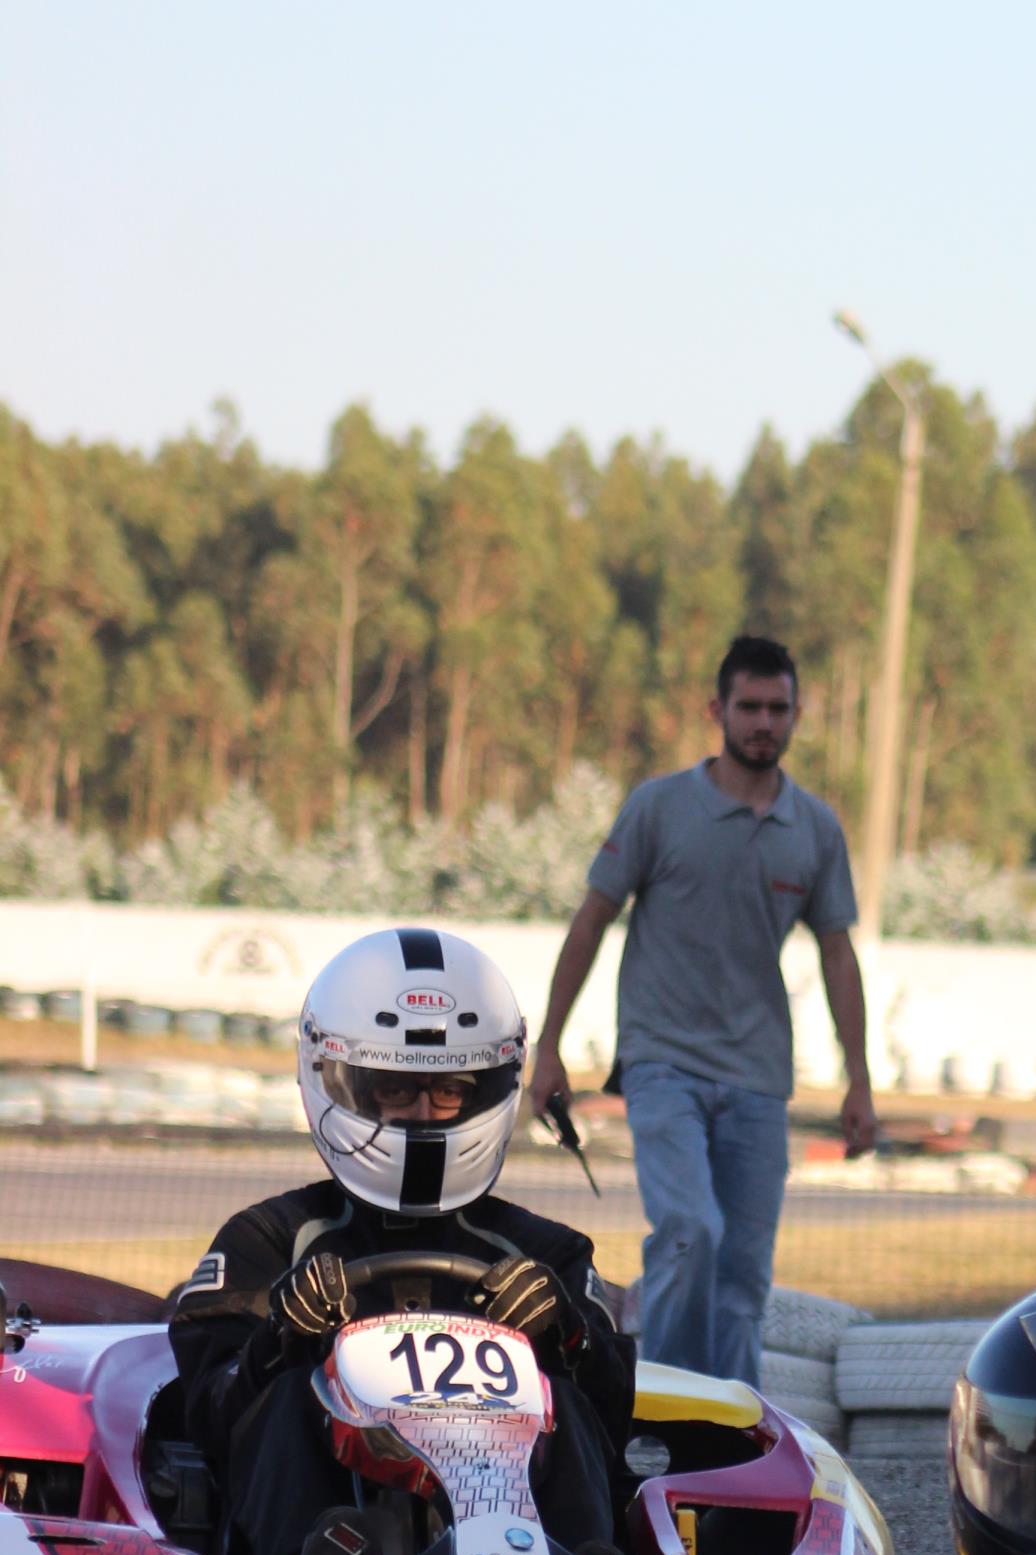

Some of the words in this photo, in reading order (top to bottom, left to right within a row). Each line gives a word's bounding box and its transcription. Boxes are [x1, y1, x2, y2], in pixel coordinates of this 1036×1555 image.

[407, 995, 447, 1007] BELL
[325, 1040, 344, 1053] BELL
[359, 1048, 492, 1067] www.bellracing.info
[389, 1333, 519, 1397] 129
